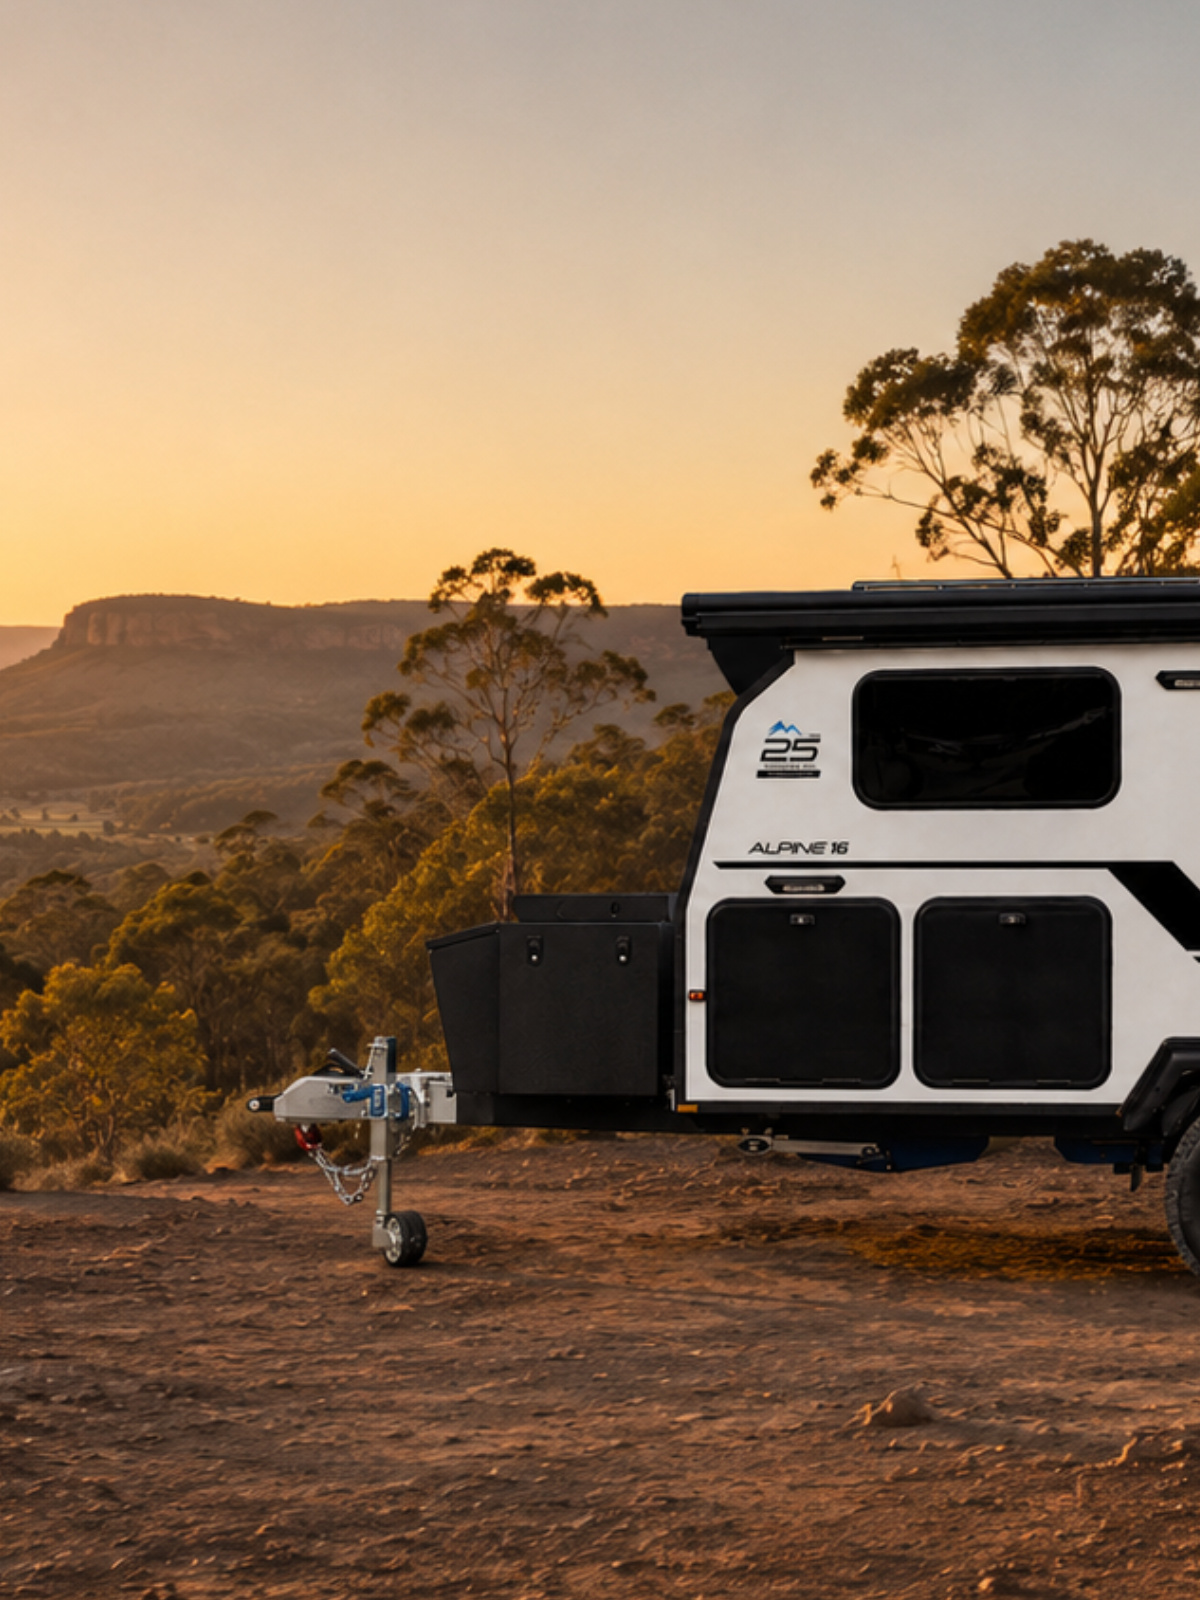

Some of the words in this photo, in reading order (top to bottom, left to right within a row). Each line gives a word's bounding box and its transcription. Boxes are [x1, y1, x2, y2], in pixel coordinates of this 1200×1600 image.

[760, 738, 821, 762] 25
[748, 841, 828, 855] ALPINE
[831, 841, 849, 855] 16
